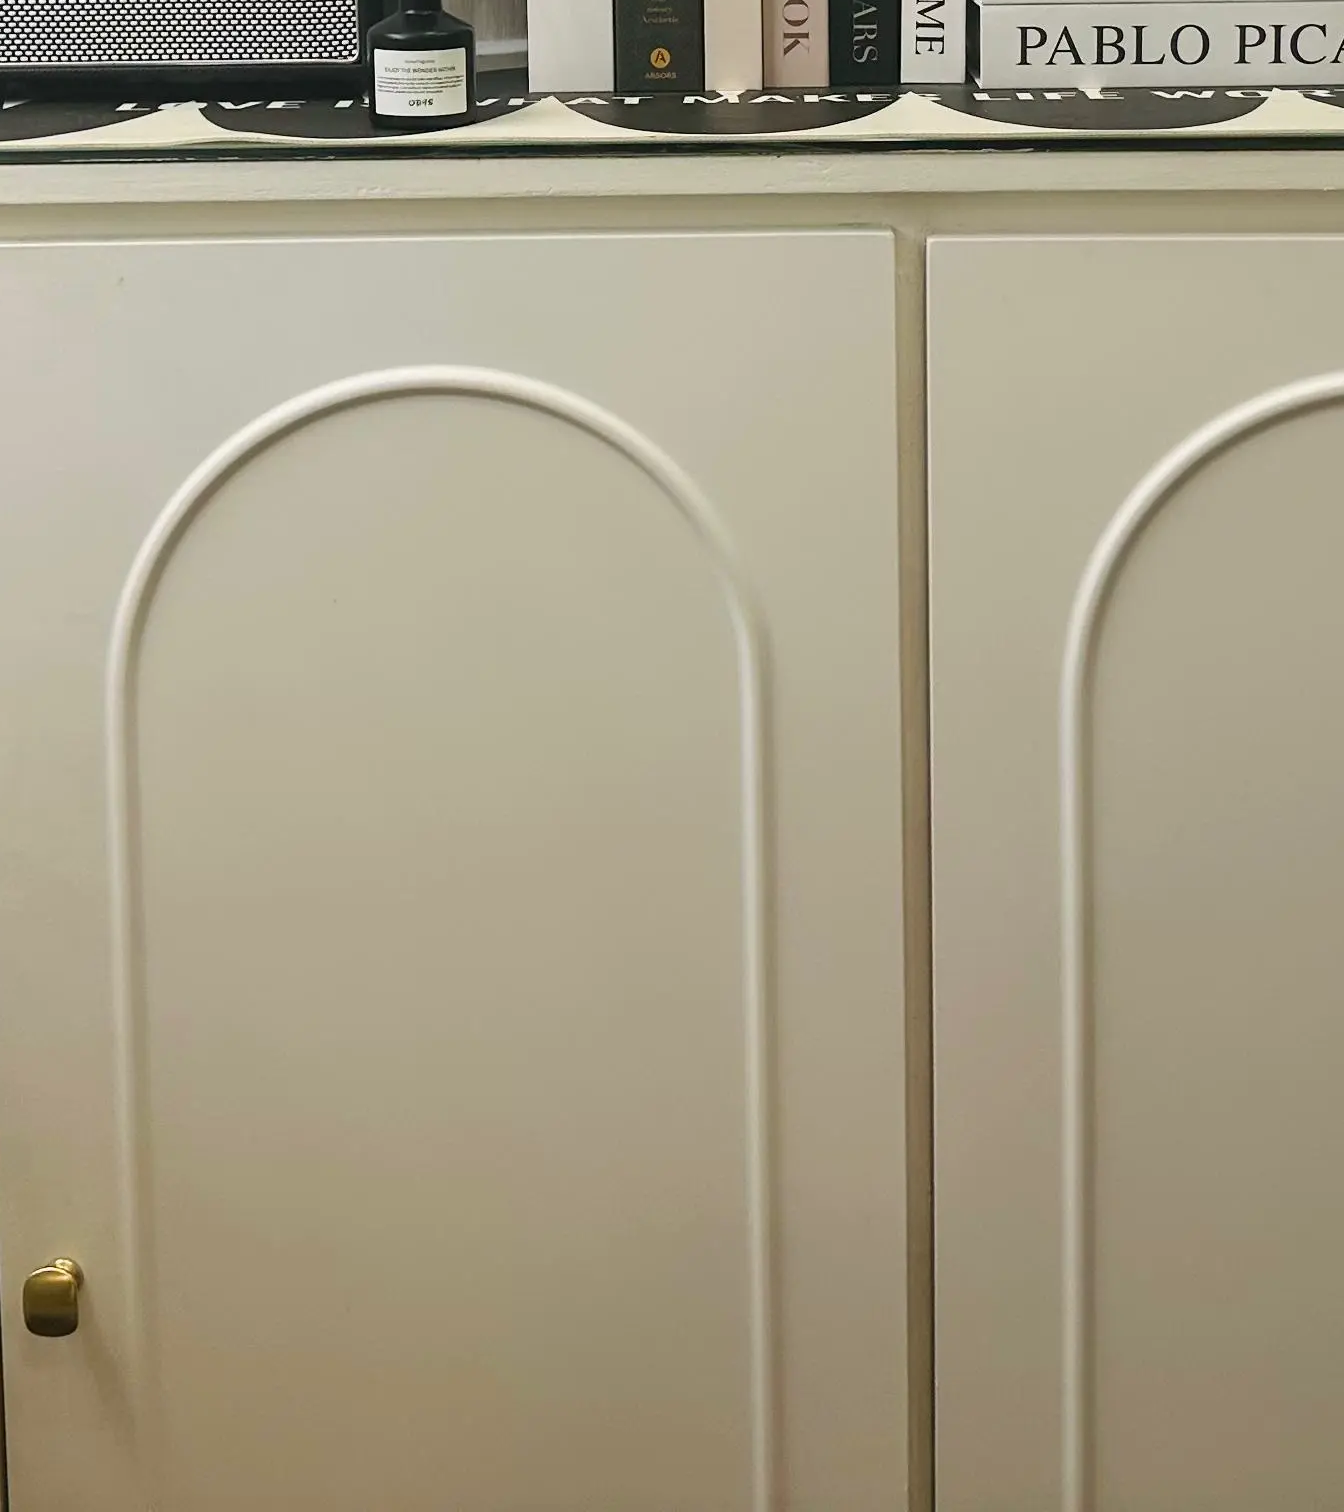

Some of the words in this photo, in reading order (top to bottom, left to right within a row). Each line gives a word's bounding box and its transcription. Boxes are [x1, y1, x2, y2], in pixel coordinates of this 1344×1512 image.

[1016, 24, 1210, 67] PABLO
[115, 99, 307, 112] LOVE
[682, 93, 942, 104] MAKES
[972, 90, 1125, 101] LIFE
